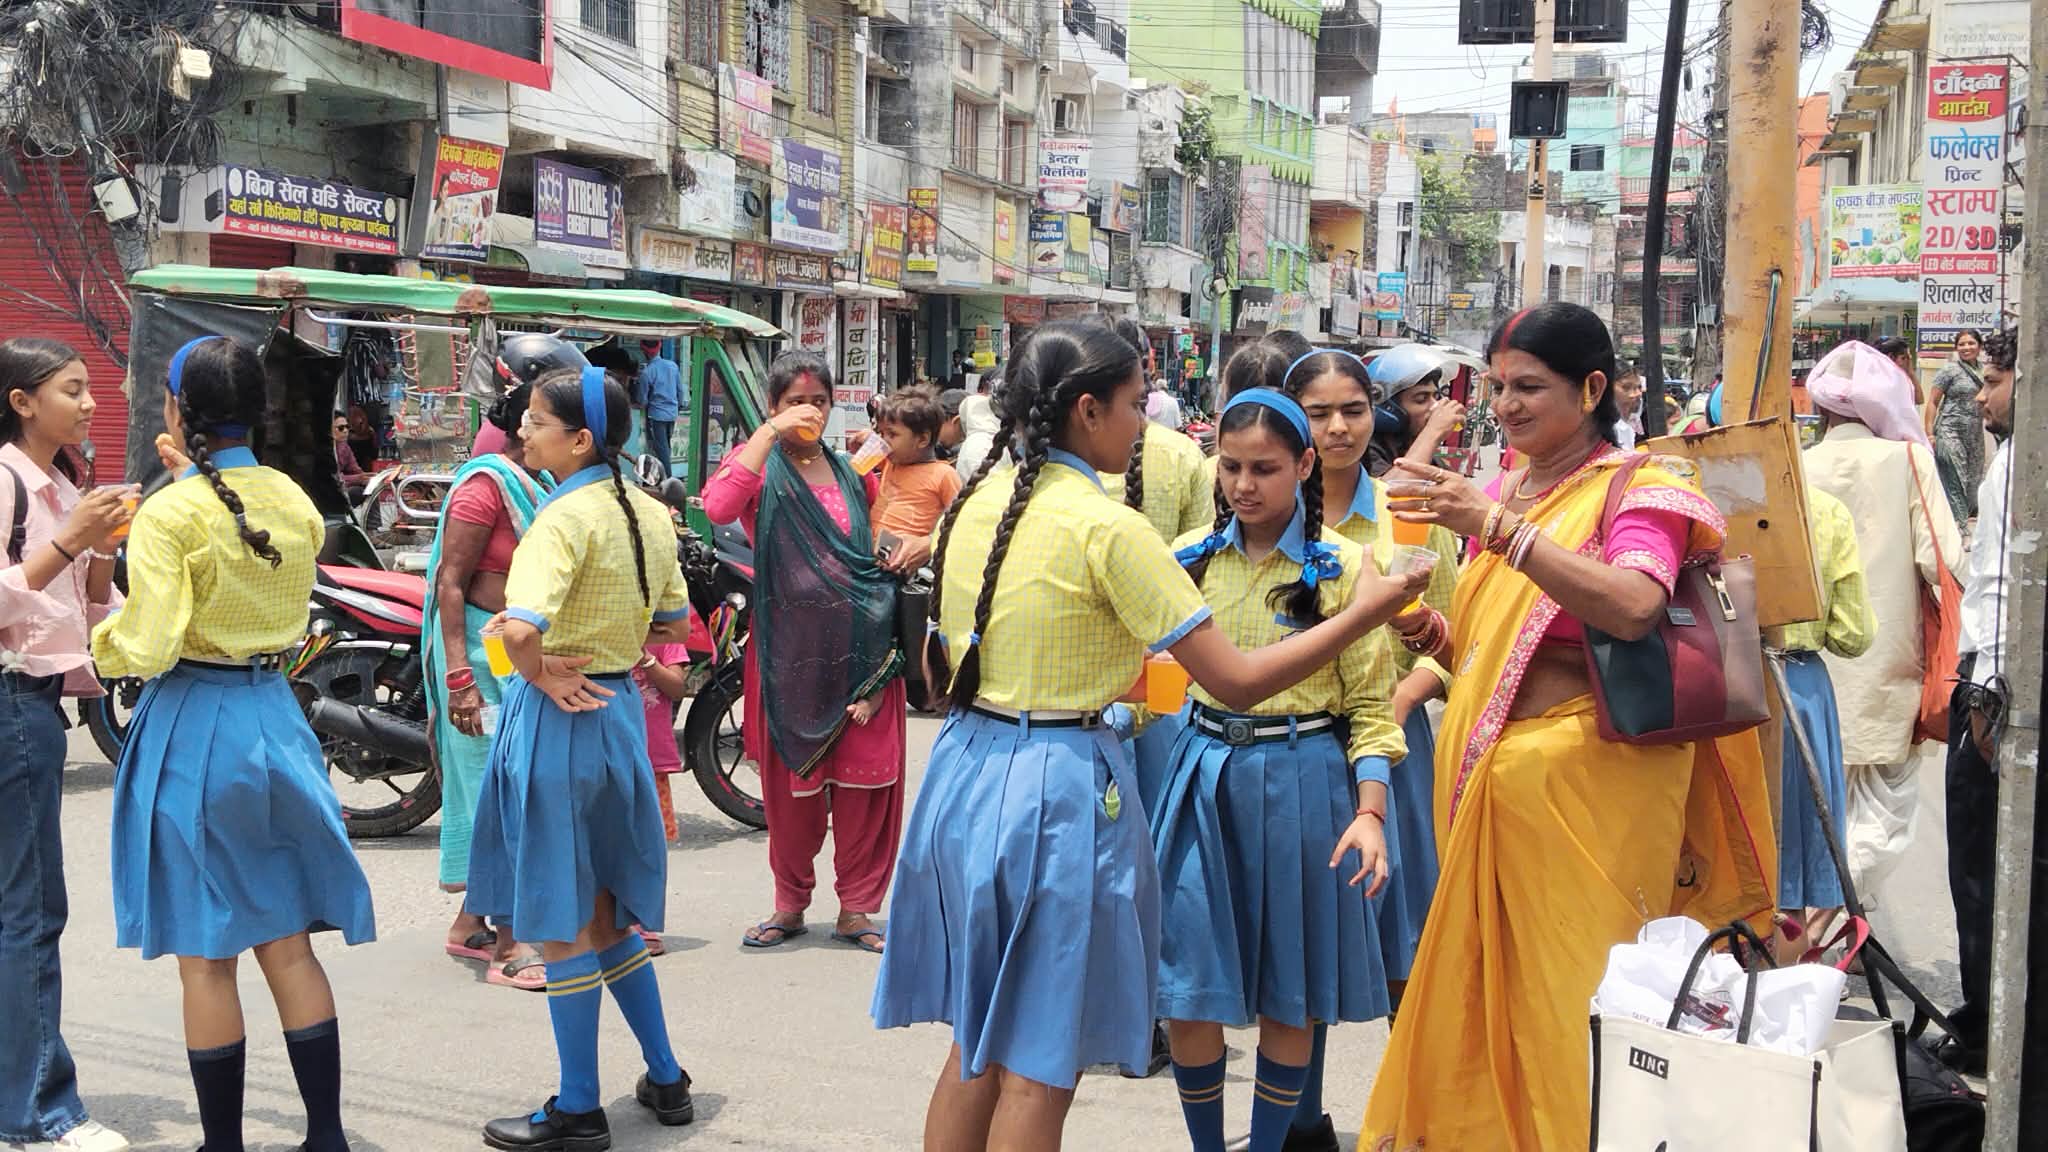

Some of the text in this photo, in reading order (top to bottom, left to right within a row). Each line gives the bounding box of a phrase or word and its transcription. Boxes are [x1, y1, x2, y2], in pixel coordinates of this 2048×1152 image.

[1933, 68, 2003, 95] चाँदनी
[1945, 166, 1982, 183] प्रिन्ट
[245, 170, 383, 218] बिग सेल घडि सेन्टर
[567, 177, 608, 218] XTREME
[1927, 189, 1998, 216] स्टाम्प
[1925, 225, 1996, 250] 2D/3D
[1923, 278, 1994, 304] शिलालेख
[1632, 1051, 1665, 1075] LINC
